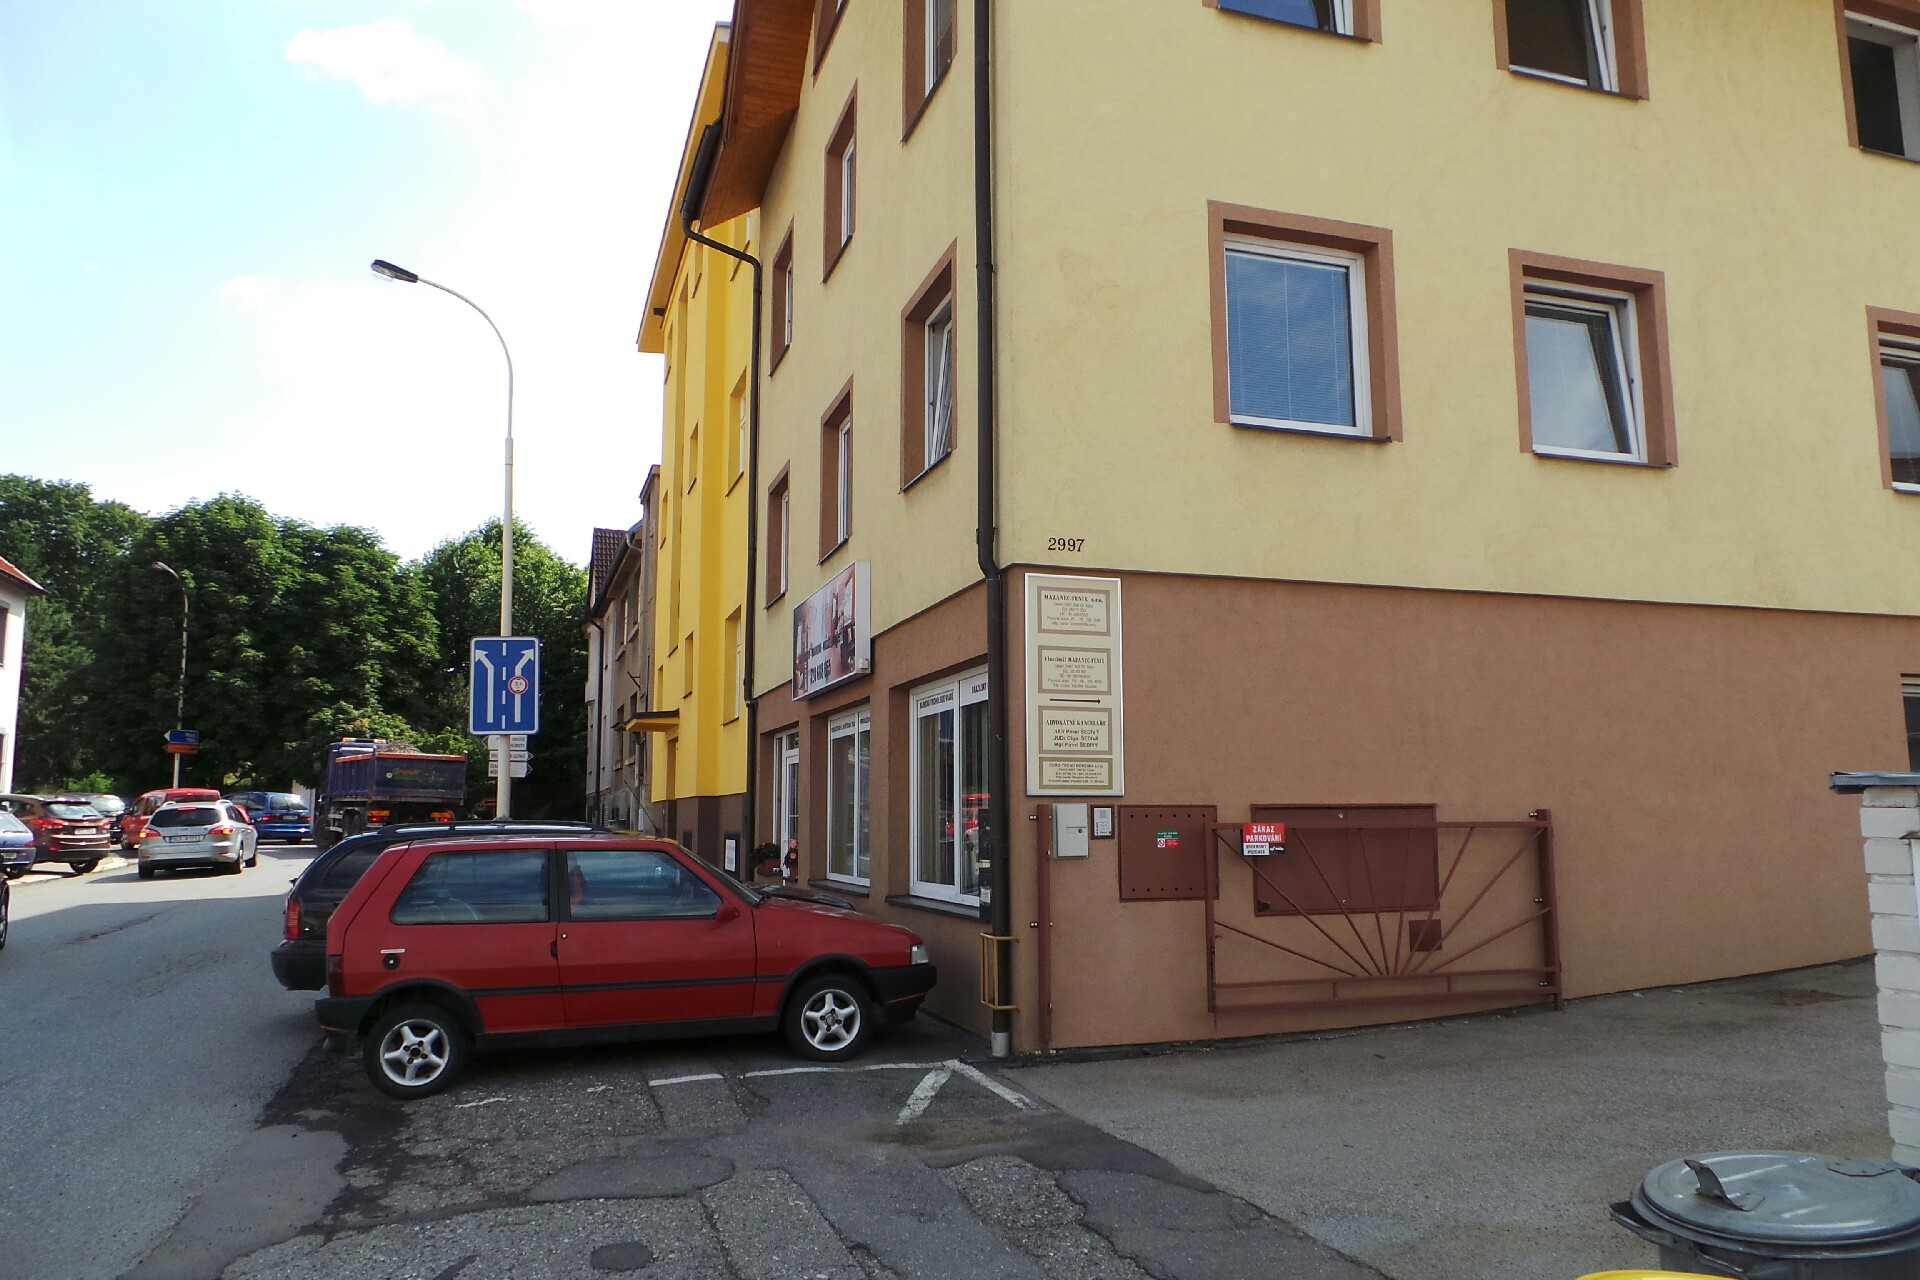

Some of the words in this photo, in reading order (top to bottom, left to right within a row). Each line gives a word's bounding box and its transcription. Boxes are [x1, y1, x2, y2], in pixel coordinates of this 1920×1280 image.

[1047, 537, 1086, 552] 2997
[1252, 825, 1275, 833] ZÁKAZ
[1245, 833, 1282, 842] PARKOVÁNÍ
